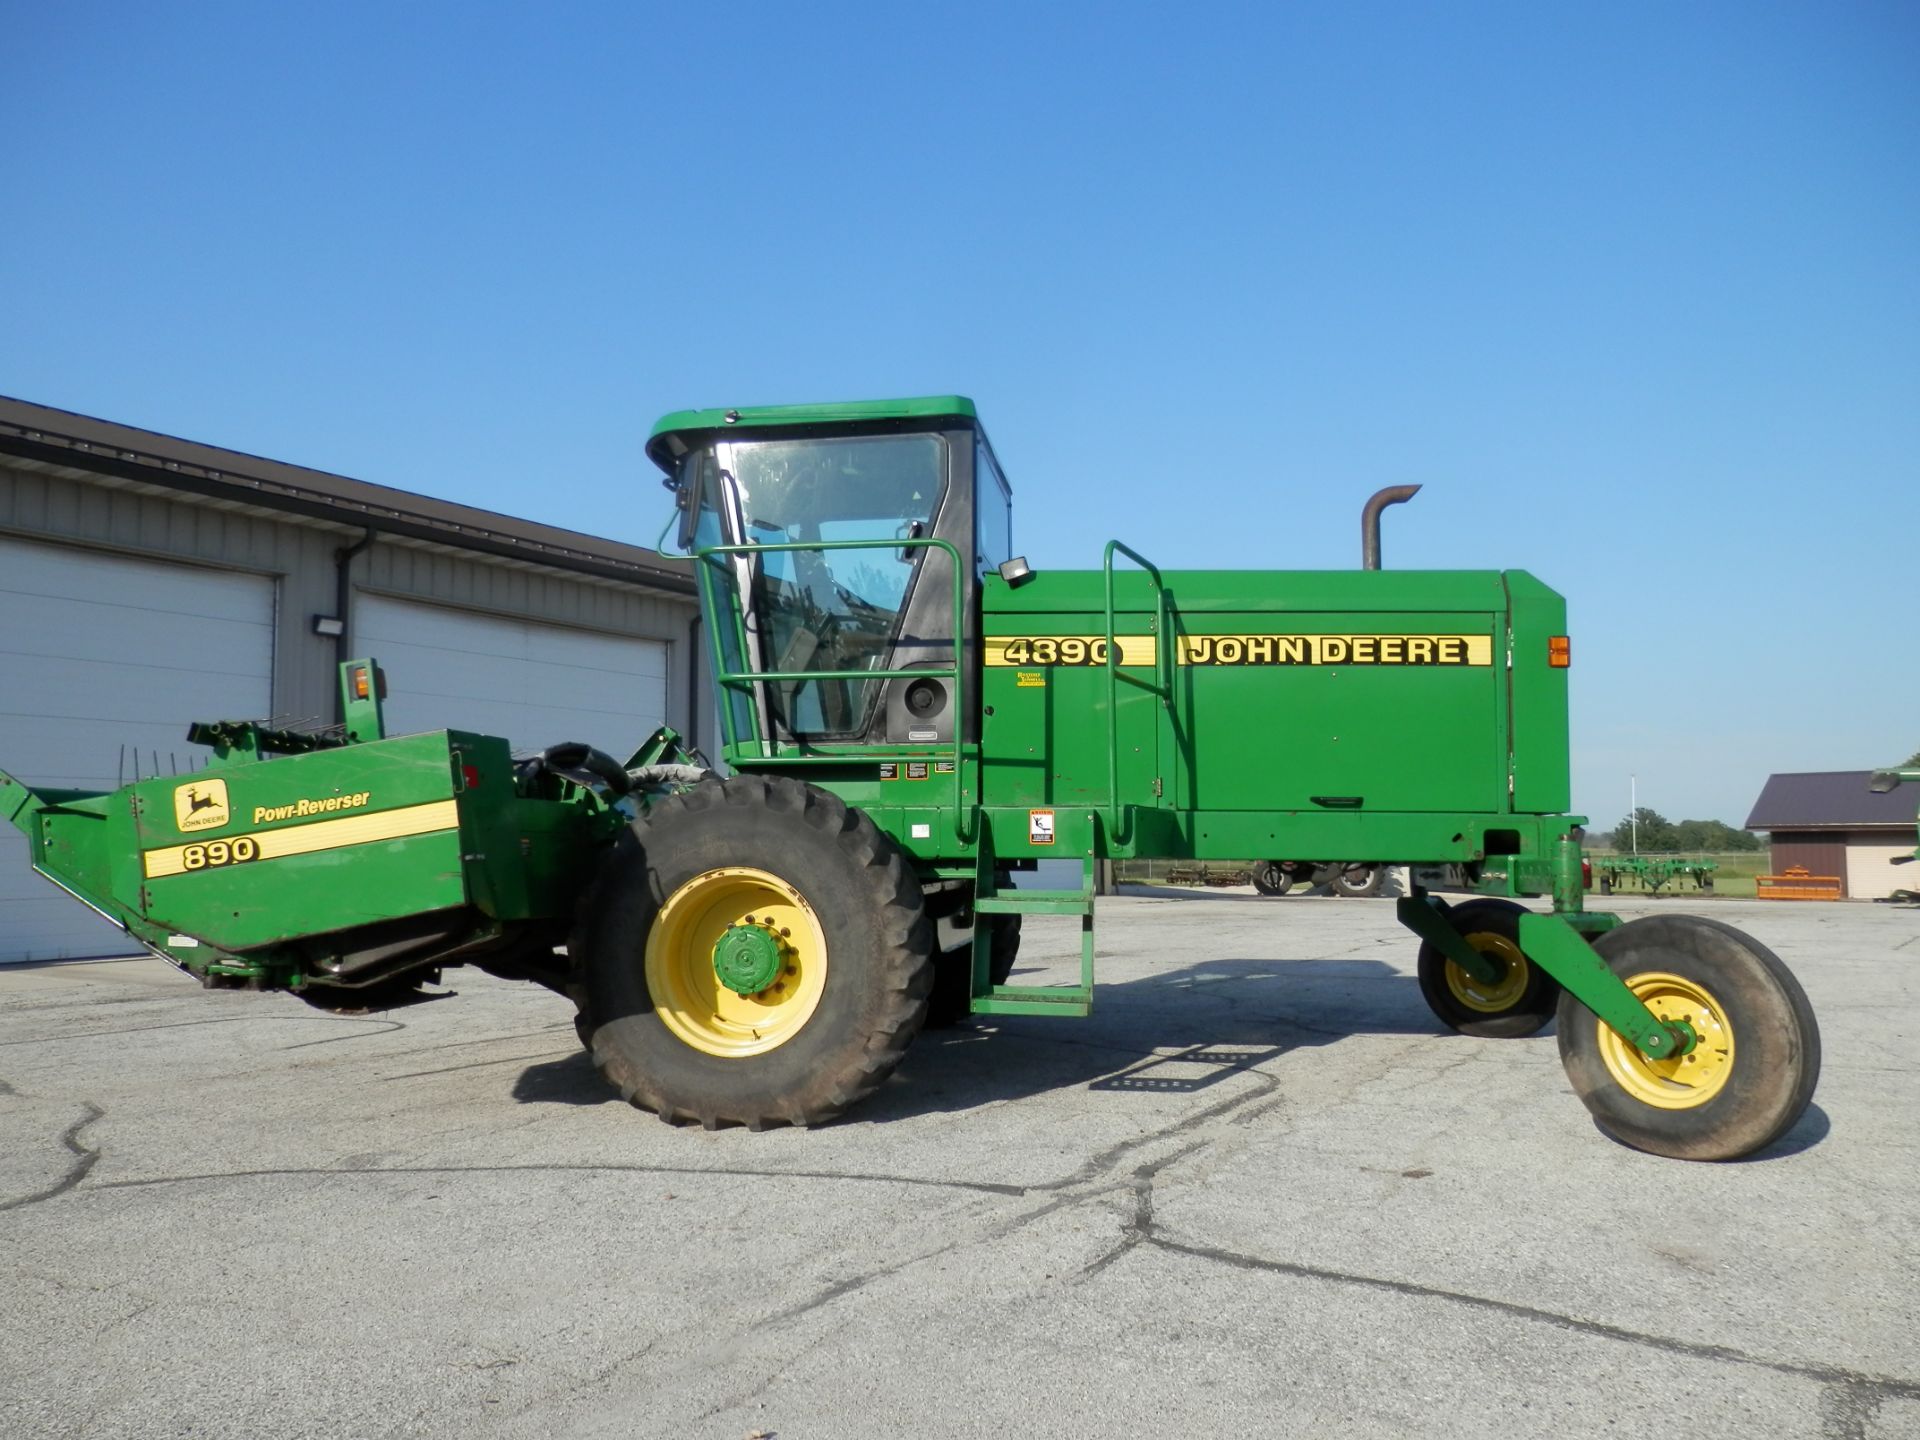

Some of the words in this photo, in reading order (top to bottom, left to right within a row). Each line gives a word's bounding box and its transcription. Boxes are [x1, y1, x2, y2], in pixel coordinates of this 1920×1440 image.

[1188, 638, 1309, 664] JOHN
[1320, 638, 1466, 664] DEERE
[181, 820, 202, 829] JOHN
[202, 815, 226, 825] DEERE
[254, 791, 370, 824] Powr-Reverser
[183, 837, 258, 871] 890
